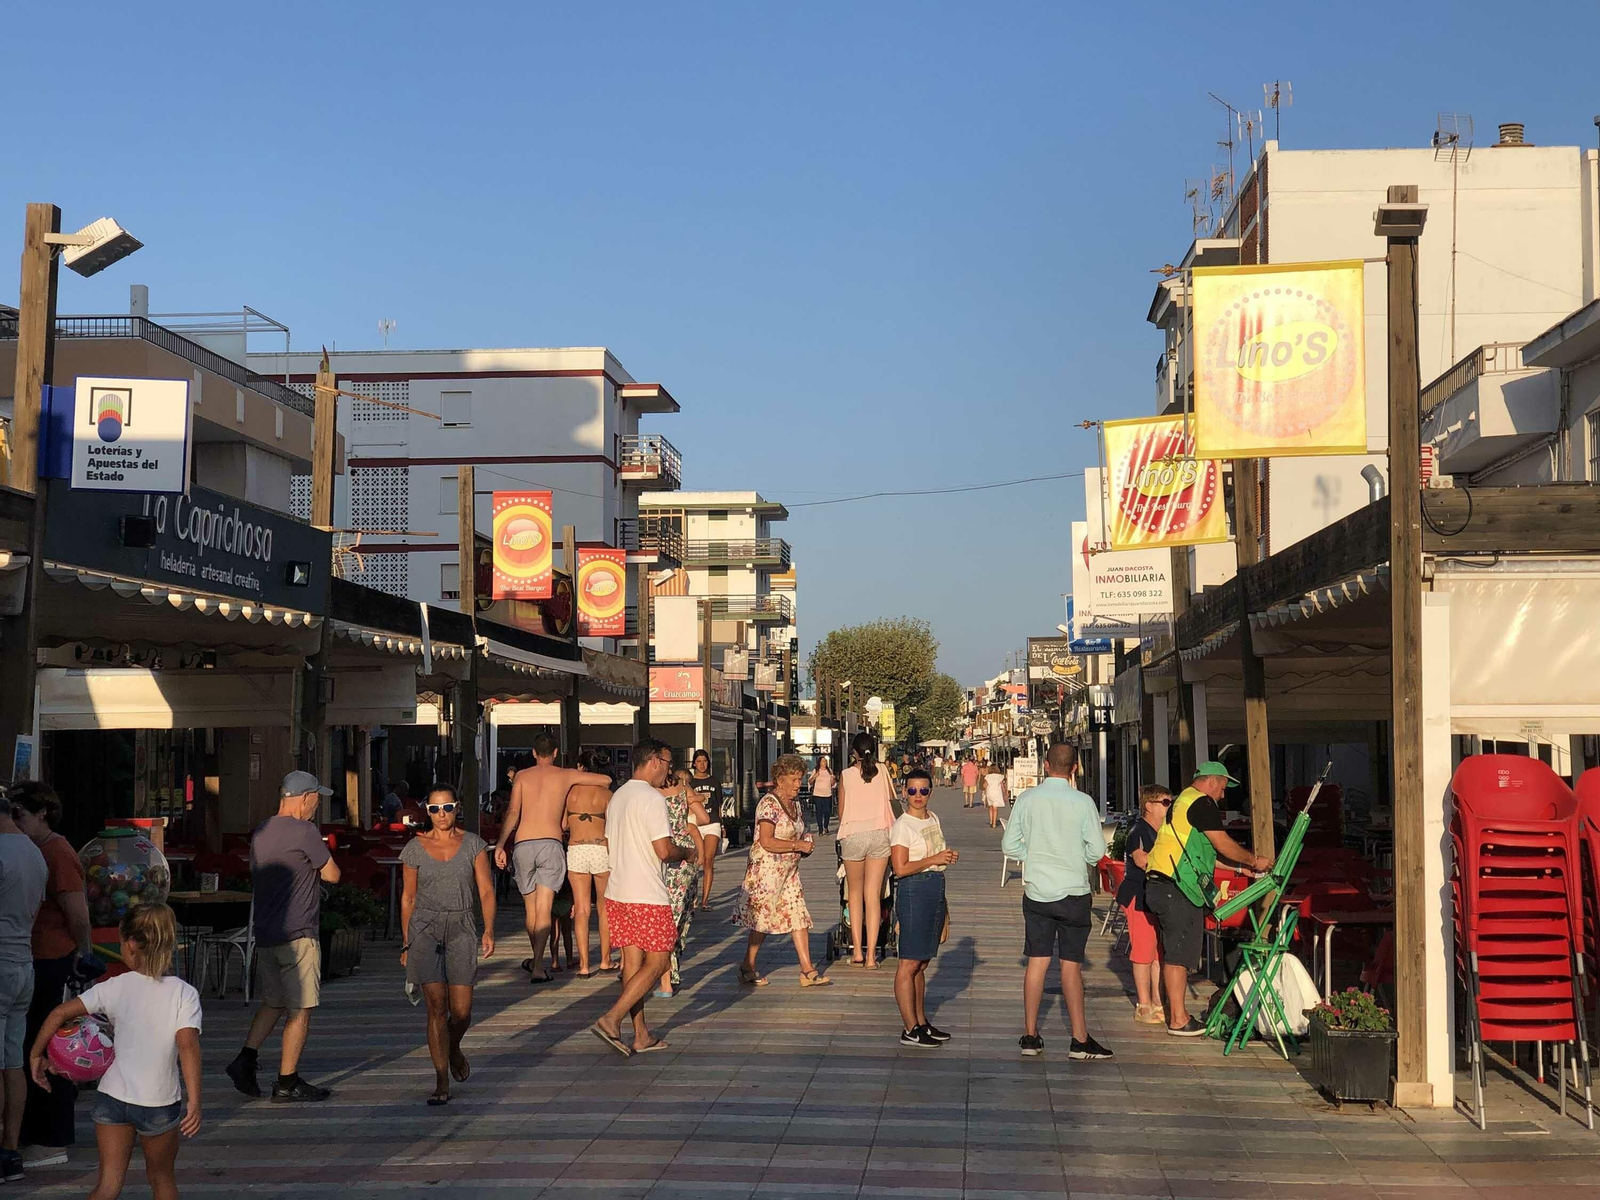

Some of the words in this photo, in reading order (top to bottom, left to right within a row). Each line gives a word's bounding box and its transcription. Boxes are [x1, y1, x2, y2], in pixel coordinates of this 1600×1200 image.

[87, 444, 133, 456] Loterías
[135, 448, 142, 458] y
[87, 457, 139, 470] Apuestas
[141, 459, 158, 470] del
[86, 470, 124, 481] Estado
[1136, 504, 1150, 513] The
[174, 494, 273, 562] Caprichosa
[201, 563, 233, 586] artesanal
[234, 571, 260, 591] creativa
[1095, 573, 1166, 584] INMOBILIARIA
[500, 584, 510, 592] The
[1100, 591, 1116, 599] TLF:
[1148, 589, 1163, 597] 322
[1031, 644, 1042, 652] EL
[663, 690, 701, 699] Cruzcampo
[1094, 709, 1107, 724] DE
[1109, 709, 1116, 724] V
